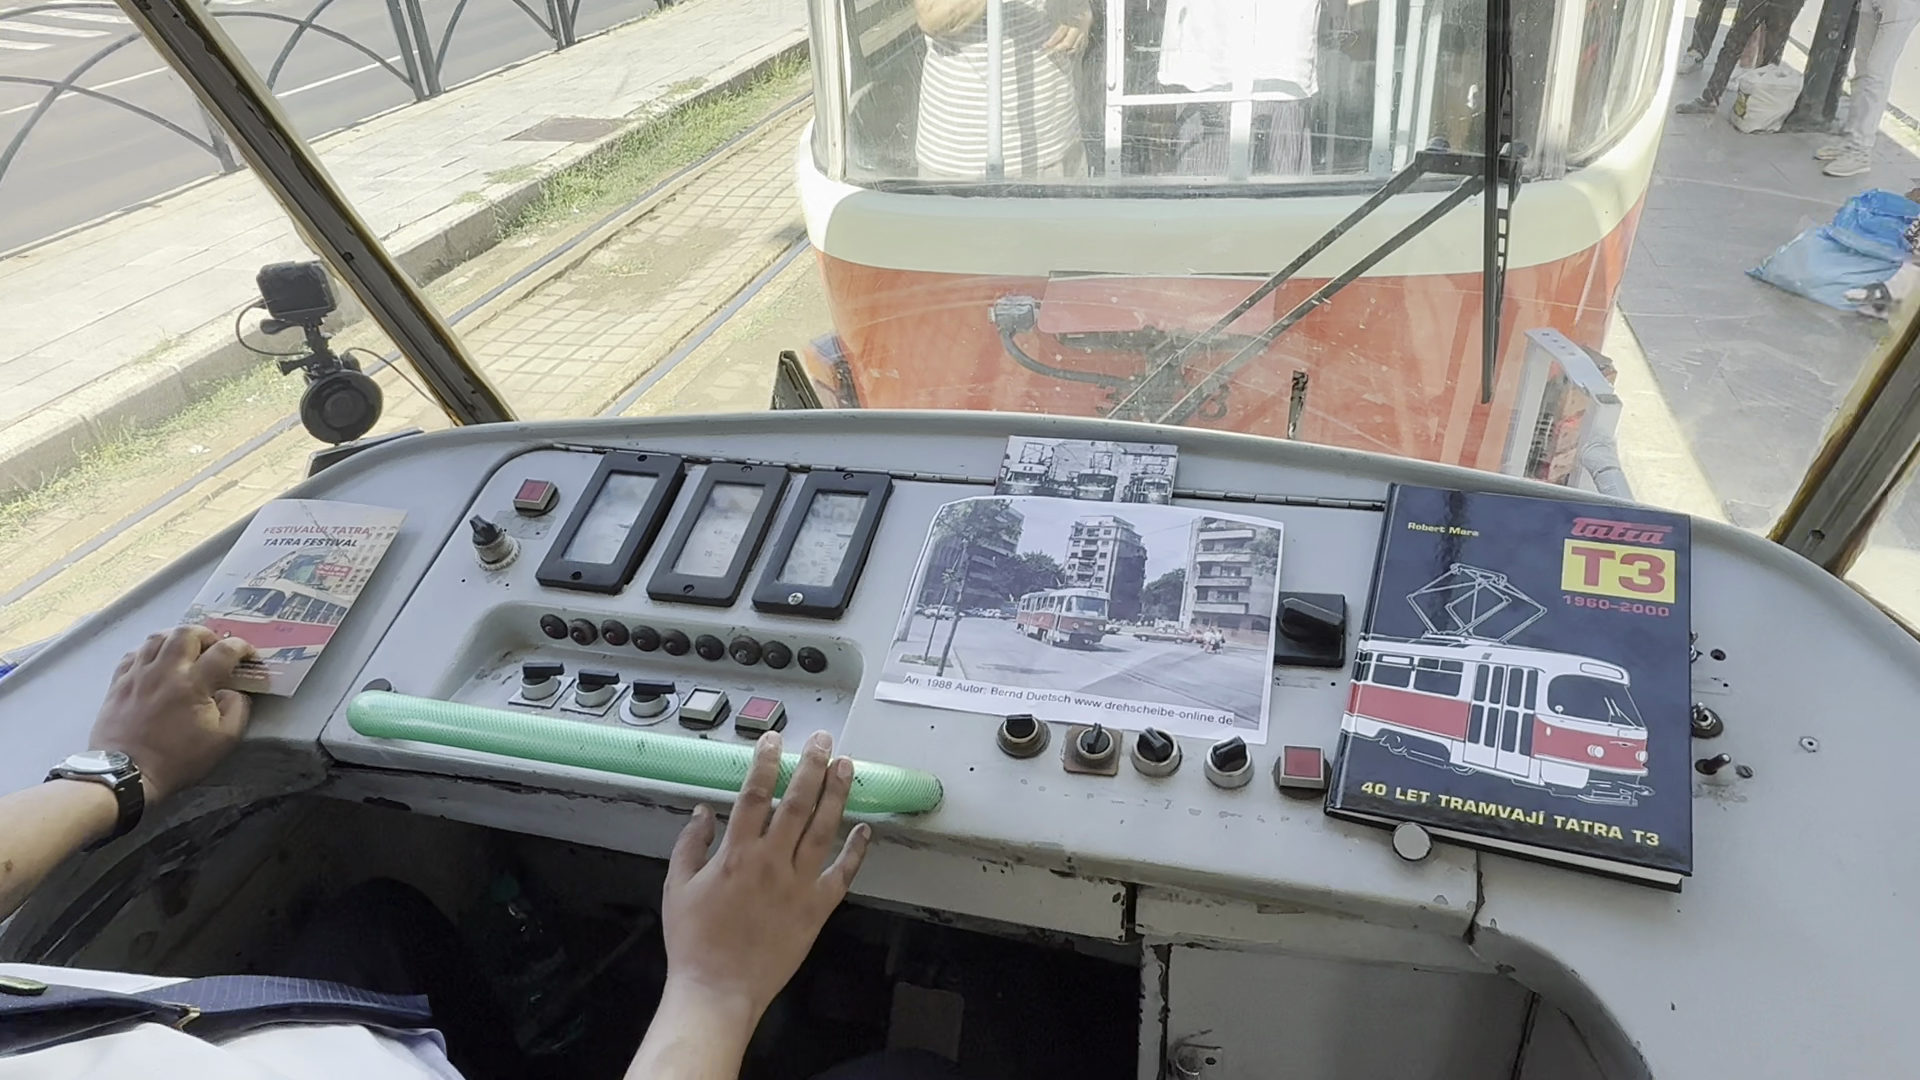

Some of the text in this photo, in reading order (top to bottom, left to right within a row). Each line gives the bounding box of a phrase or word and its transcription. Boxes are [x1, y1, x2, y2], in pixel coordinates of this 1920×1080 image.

[263, 525, 371, 535] FESTIVALUL TATRA
[1407, 522, 1480, 537] Robert Mara
[263, 538, 358, 547] TATRA FESTIVAL
[1571, 546, 1666, 594] T3
[1562, 595, 1670, 617] 1960-2000
[926, 678, 953, 690] 1988
[954, 682, 987, 695] Autor:
[990, 686, 1024, 700] Bernd
[1025, 690, 1072, 704] Duetsch
[1361, 781, 1661, 847] 40 LET TRAMVAJÍ TATRA T3
